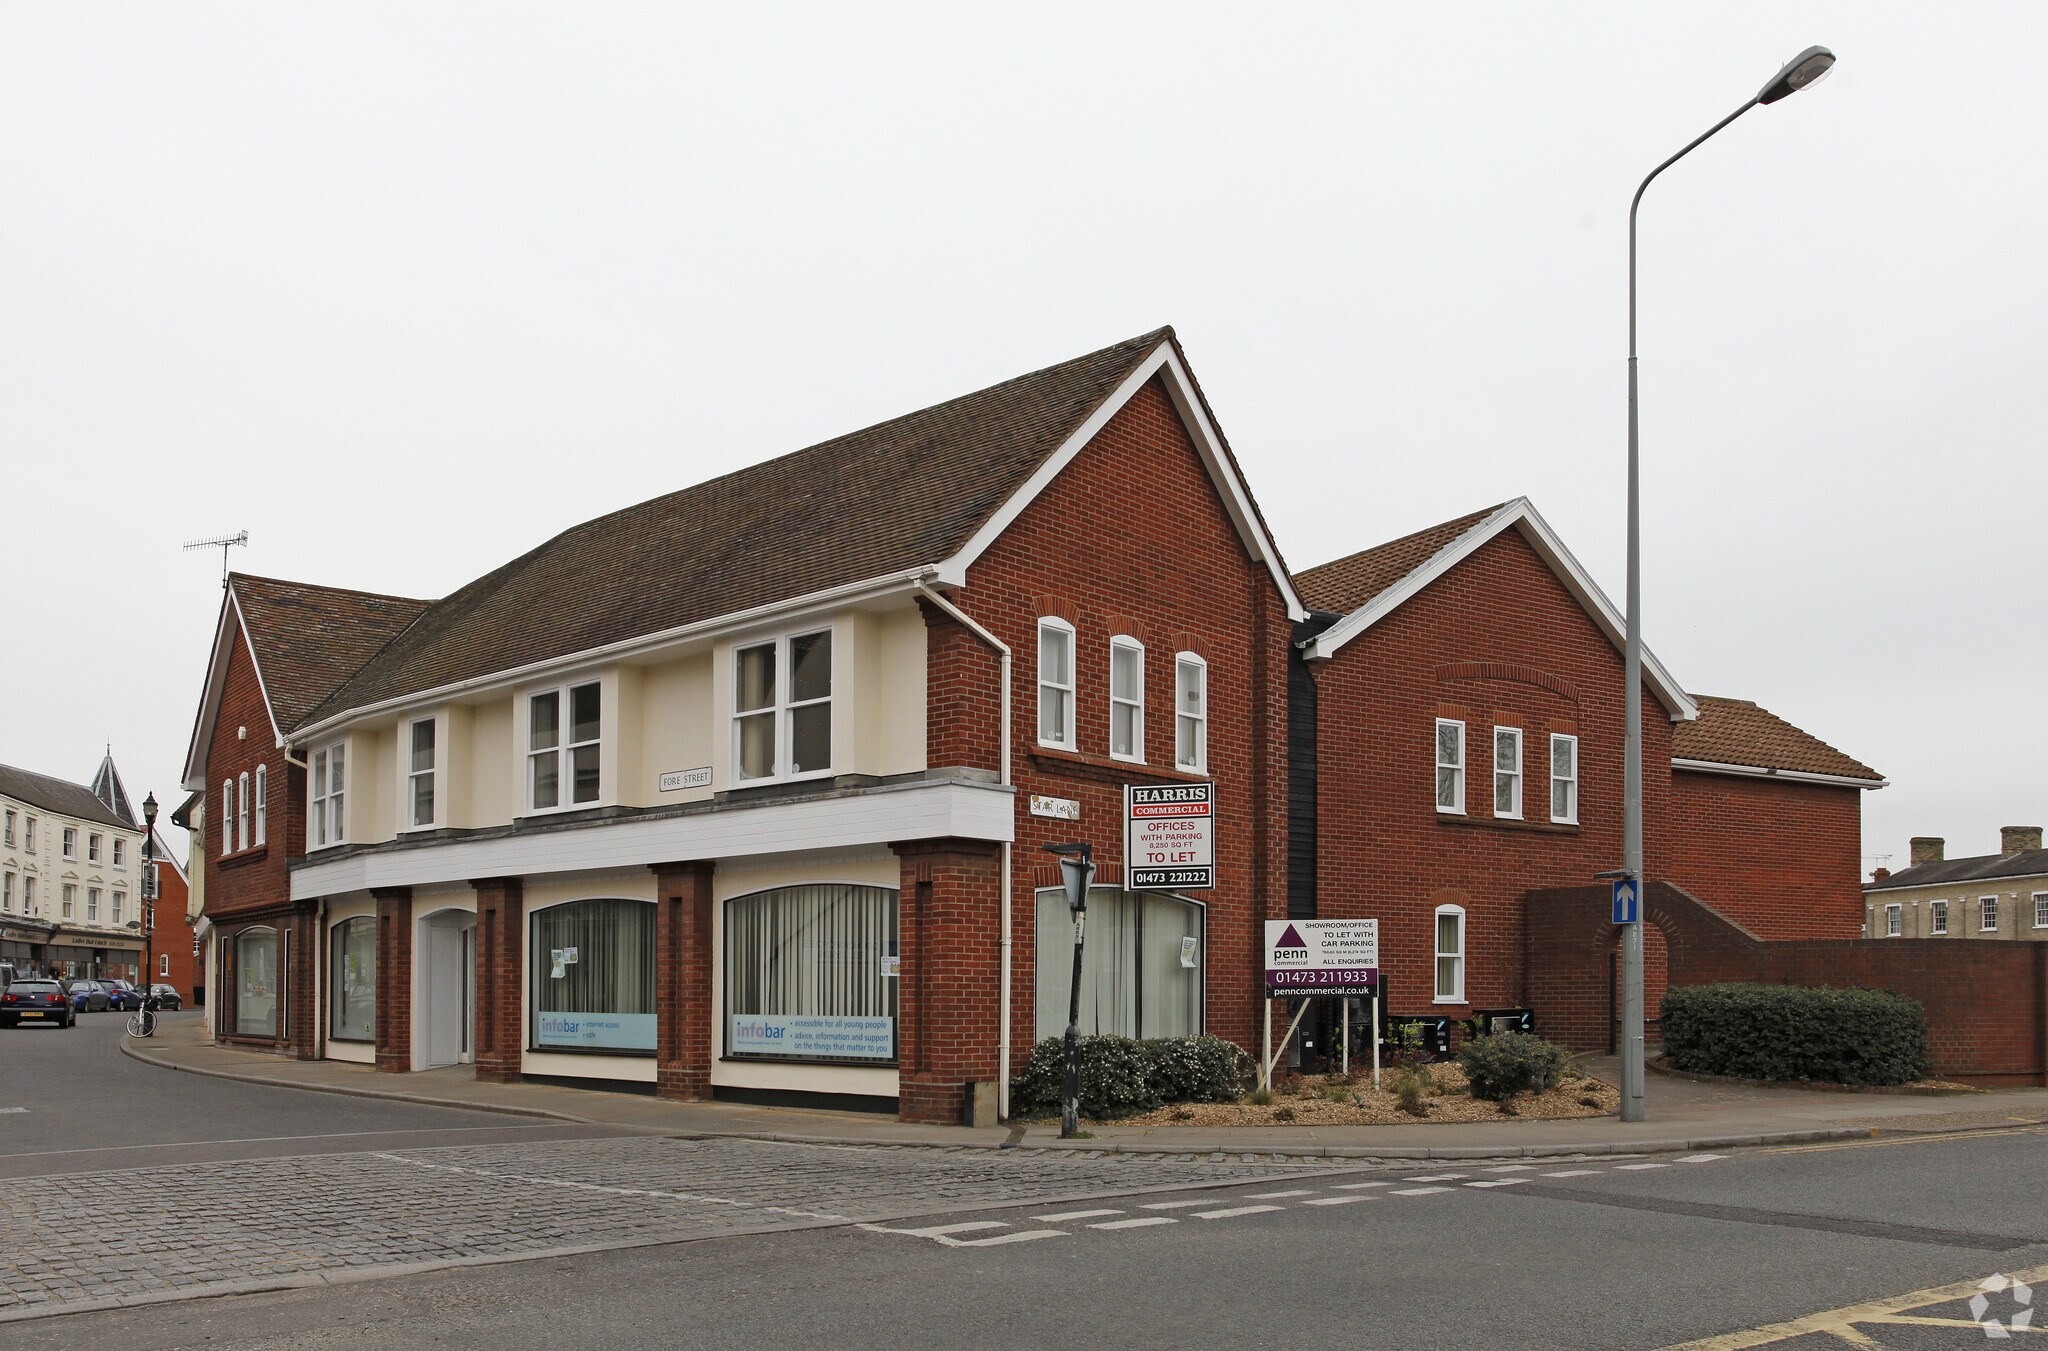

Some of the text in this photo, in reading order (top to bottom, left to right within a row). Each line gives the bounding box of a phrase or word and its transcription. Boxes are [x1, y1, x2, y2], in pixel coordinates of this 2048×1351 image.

[664, 772, 708, 786] FORE STREET
[1135, 788, 1206, 802] HARRIS
[1056, 804, 1077, 816] LANE
[1136, 806, 1206, 815] COMMERCIAL
[1148, 822, 1195, 831] OFFICES
[1147, 852, 1196, 863] TO LET
[1136, 872, 1206, 883] 01473 221222
[1274, 950, 1308, 961] penn
[1276, 971, 1367, 983] 01473 211933
[1274, 986, 1369, 996] penncommercial.co.uk
[542, 1018, 579, 1033] infobar
[737, 1022, 785, 1038] infobar
[844, 1022, 863, 1030] young
[865, 1021, 887, 1030] people
[851, 1033, 863, 1041] and
[864, 1035, 889, 1043] support
[813, 1043, 832, 1052] things
[833, 1043, 845, 1051] that
